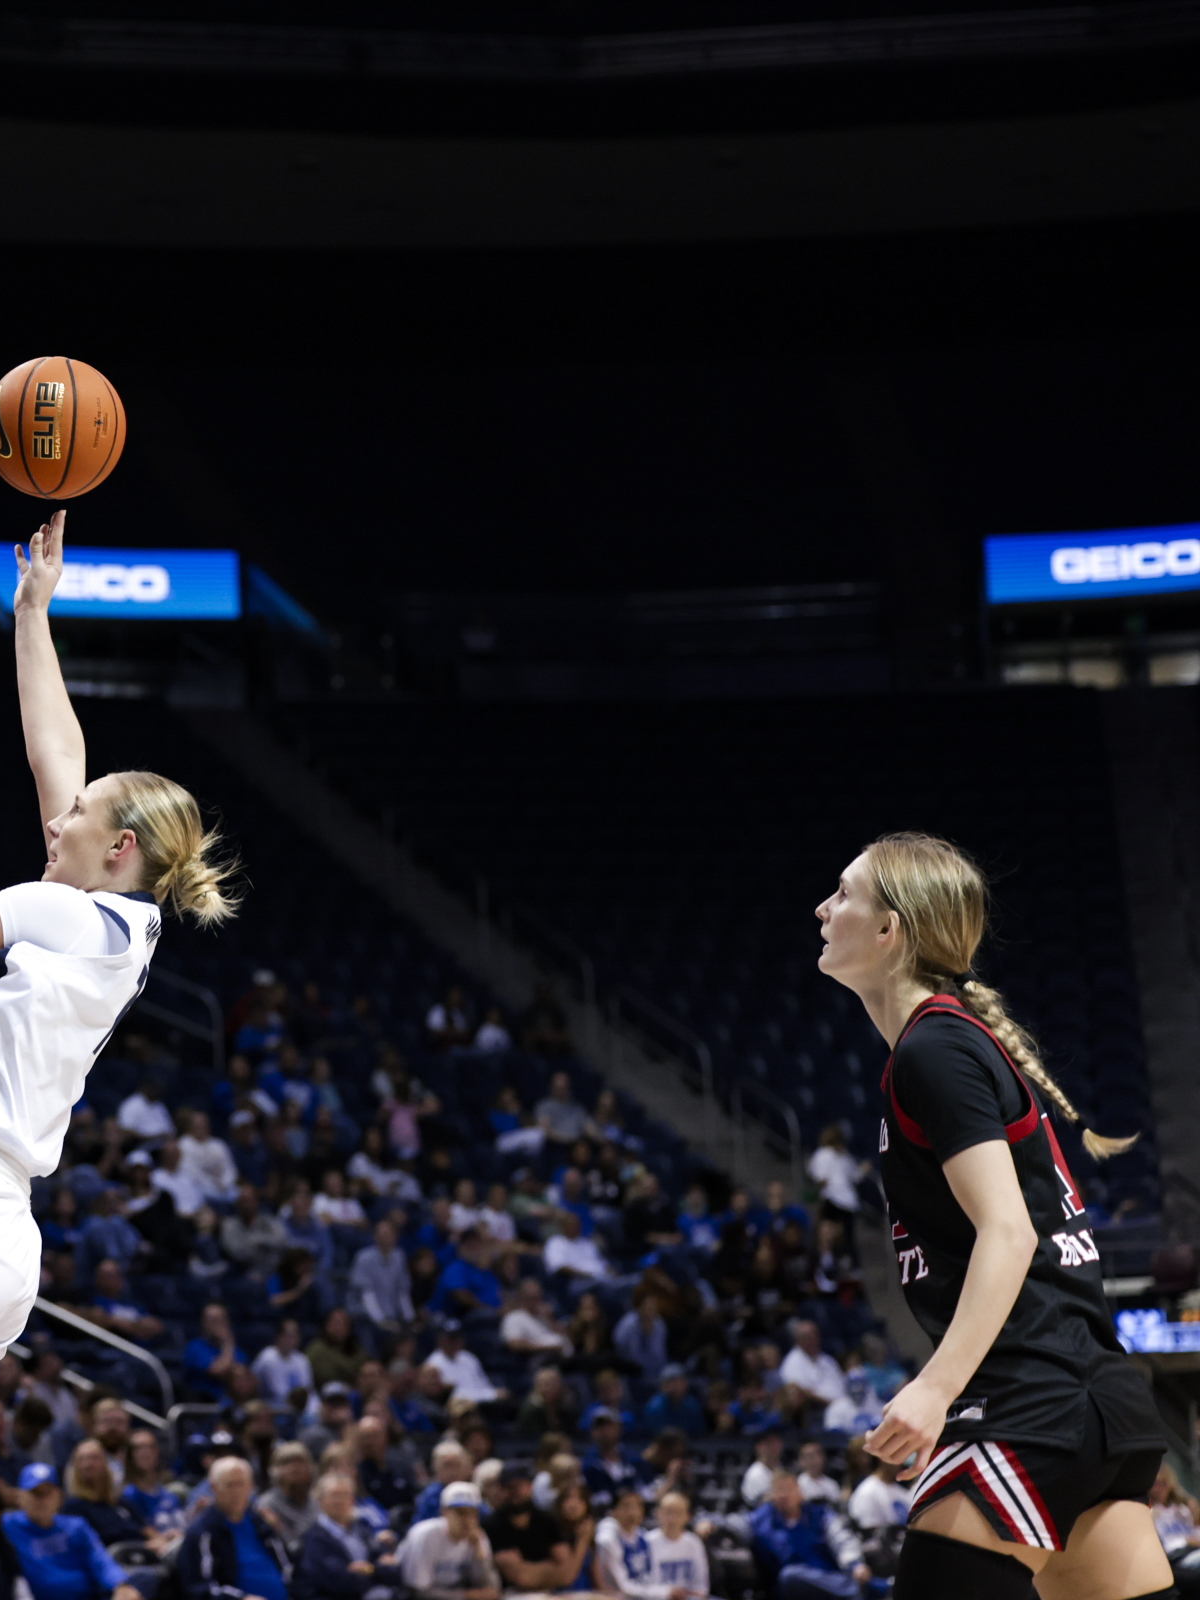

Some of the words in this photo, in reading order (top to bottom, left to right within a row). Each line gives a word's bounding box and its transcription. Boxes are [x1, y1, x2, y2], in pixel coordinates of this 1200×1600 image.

[32, 382, 60, 459] ELITE
[18, 562, 170, 603] EICO
[1050, 538, 1200, 584] GEICO
